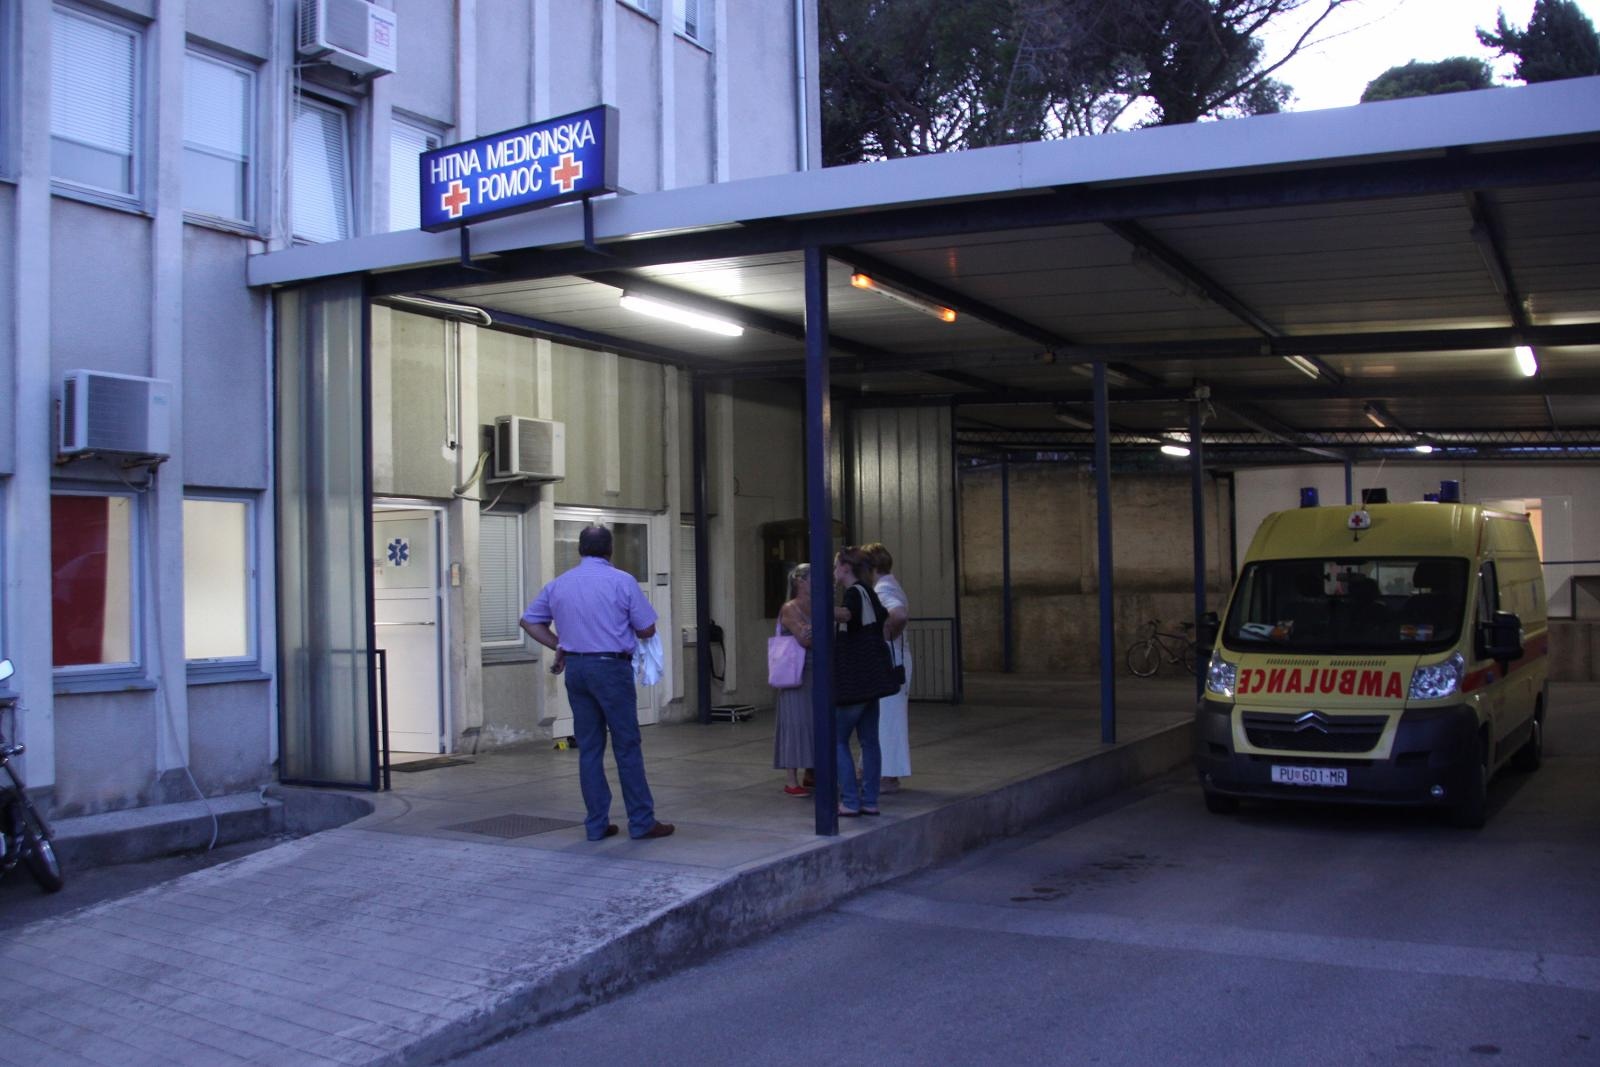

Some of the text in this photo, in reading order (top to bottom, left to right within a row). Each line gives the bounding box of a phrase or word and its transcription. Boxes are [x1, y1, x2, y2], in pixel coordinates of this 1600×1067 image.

[430, 119, 596, 184] HITNA MEDICINSKA
[1280, 767, 1294, 781] PU
